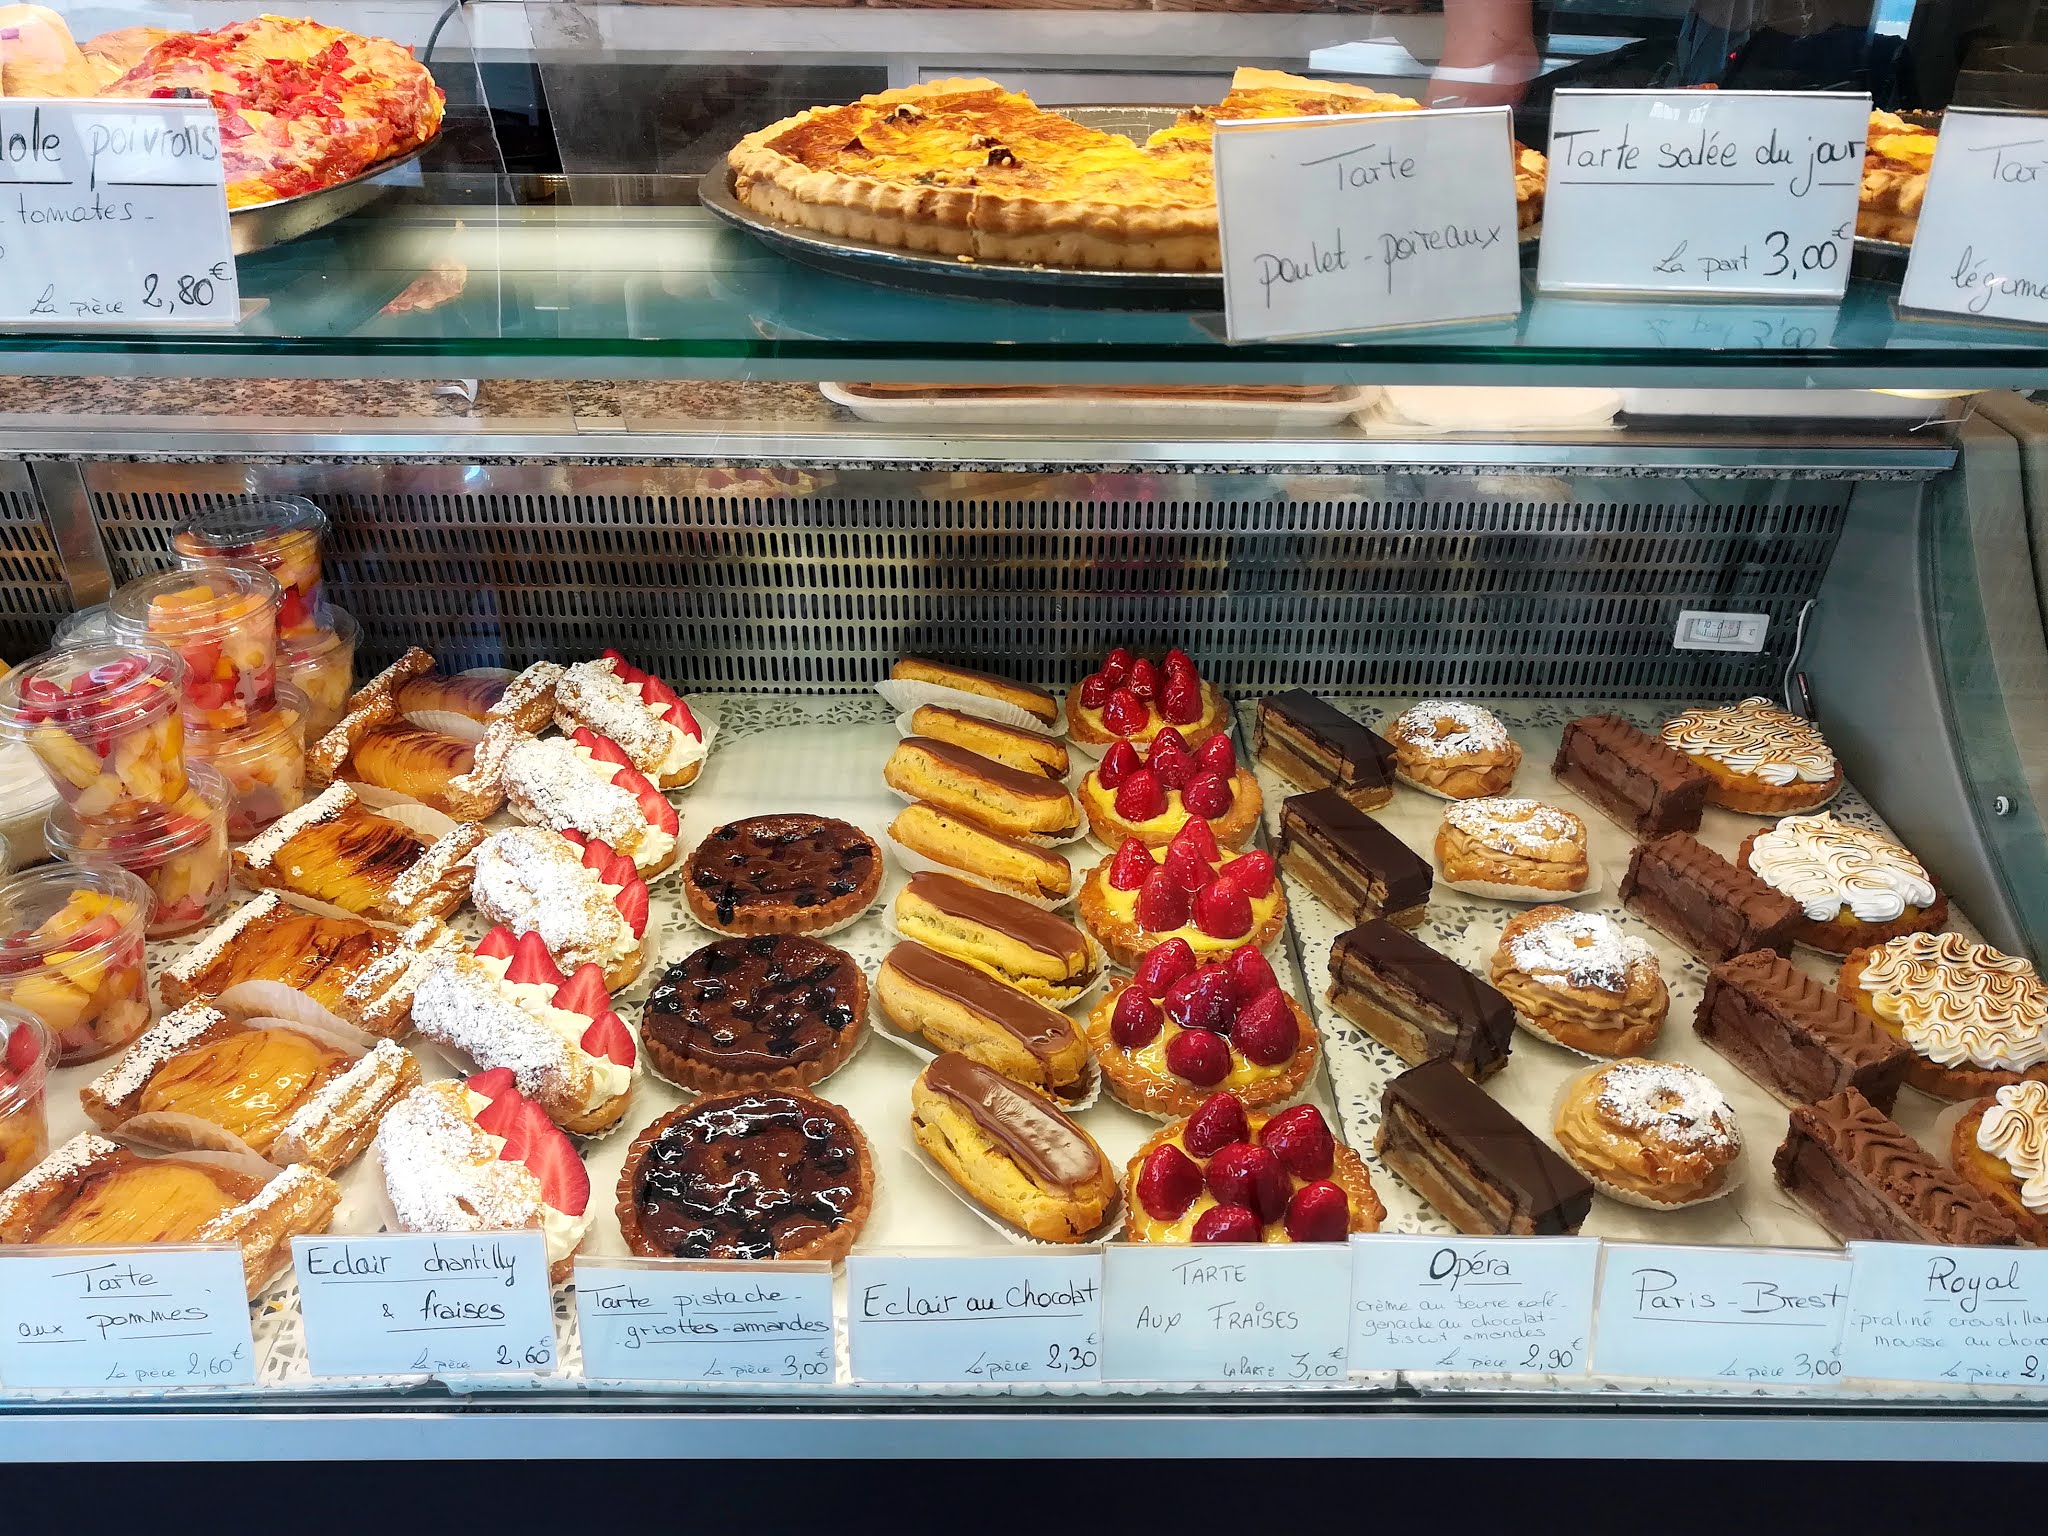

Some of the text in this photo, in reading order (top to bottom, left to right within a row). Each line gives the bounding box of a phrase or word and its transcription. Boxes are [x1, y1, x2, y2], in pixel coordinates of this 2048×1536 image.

[0, 105, 218, 192] ole poivrons
[1553, 122, 1641, 170] Tarte
[1658, 128, 1738, 169] salée
[1755, 128, 1794, 165] du
[1967, 138, 2048, 184] Tar
[1301, 143, 1417, 191] Tarte
[17, 192, 134, 224] tomates
[1652, 239, 1688, 274] La
[1698, 244, 1749, 282] part
[29, 283, 59, 315] La
[70, 298, 125, 317] pièce
[52, 1263, 158, 1293] Tarte
[307, 1241, 517, 1287] Eclair chantilly
[1171, 1257, 1247, 1286] TARTE
[1429, 1247, 1511, 1292] Opéra
[577, 1284, 655, 1309] Tarte
[863, 1277, 1099, 1317] Eclair au Chocolat
[1927, 1256, 2020, 1313] Royal
[382, 1289, 507, 1321] & fraises
[1136, 1305, 1182, 1334] AUX
[1419, 1300, 1446, 1311] au
[18, 1306, 209, 1341] aux pommes
[1438, 1318, 1462, 1330] au
[1964, 1336, 1989, 1347] au
